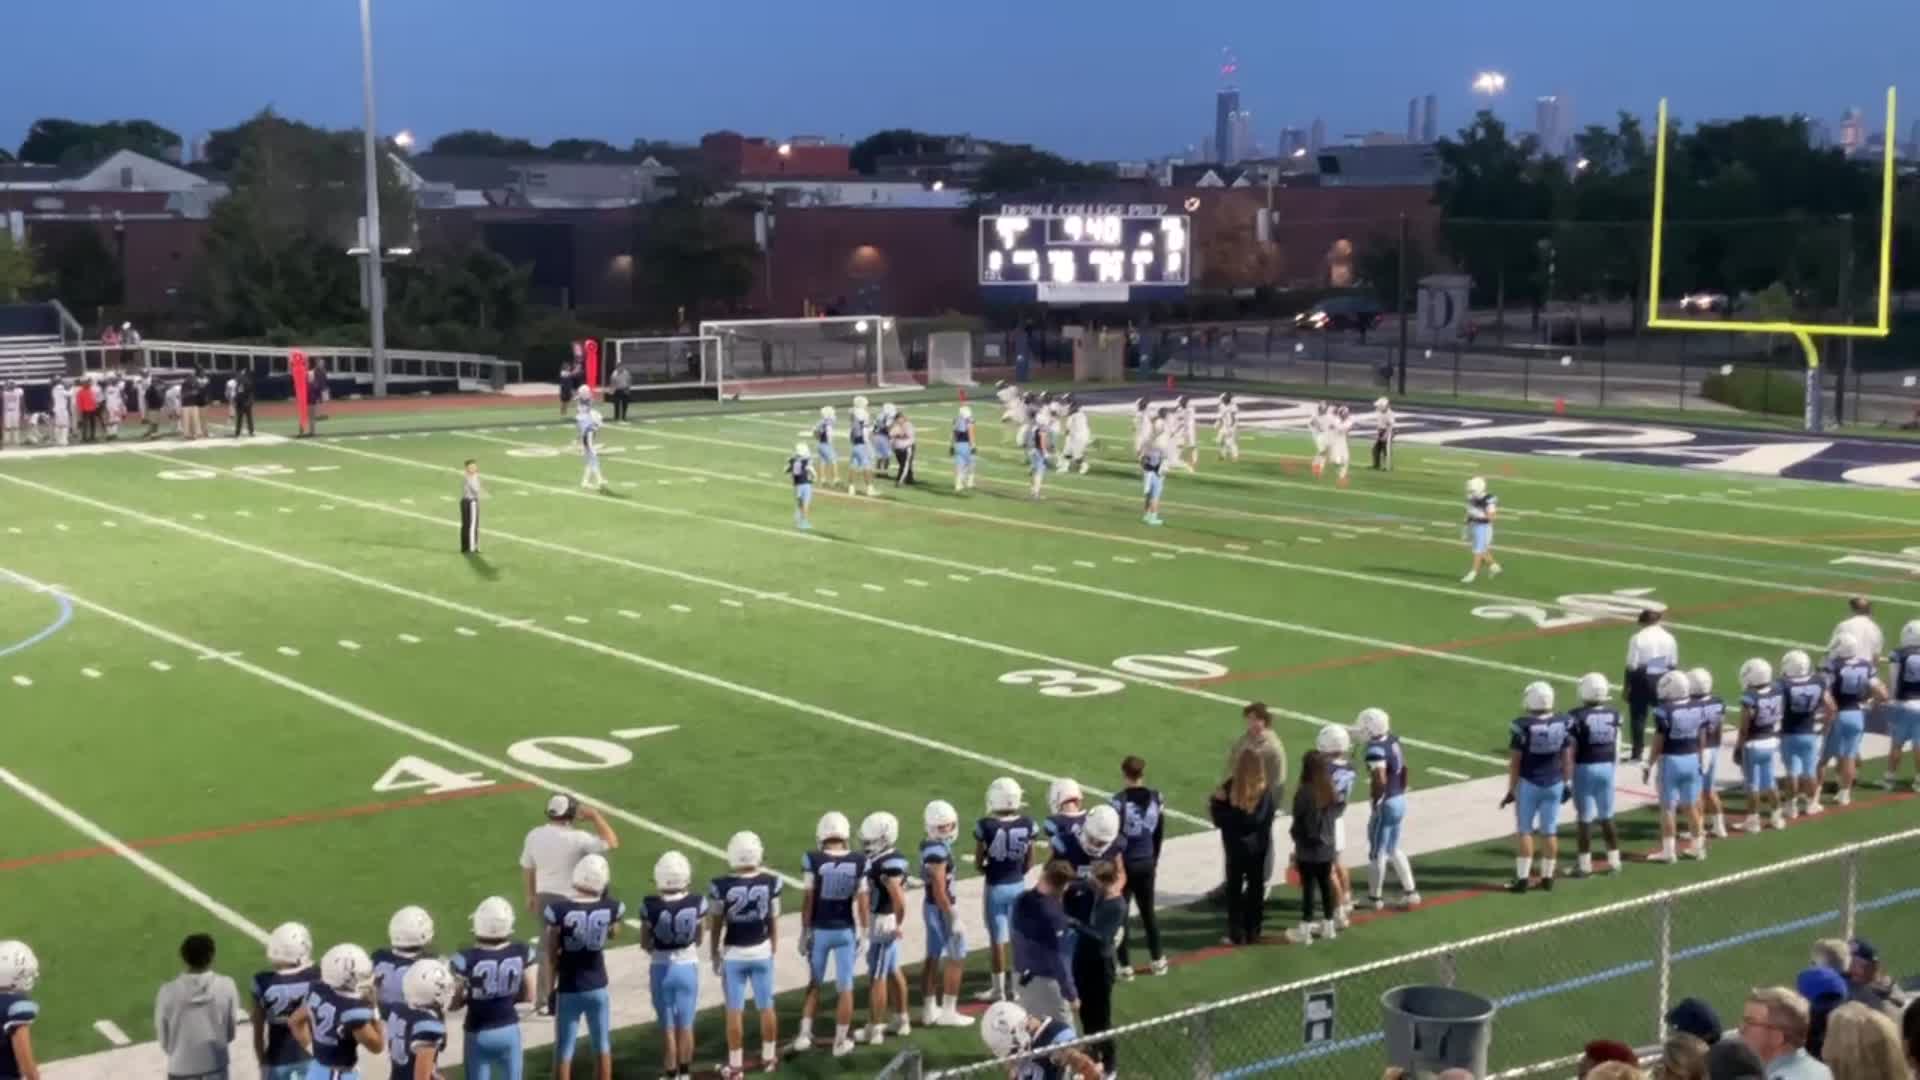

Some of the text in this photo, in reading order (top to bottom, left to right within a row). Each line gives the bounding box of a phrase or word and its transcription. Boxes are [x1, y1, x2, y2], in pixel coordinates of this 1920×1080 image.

[997, 654, 1229, 698] 30
[372, 736, 633, 794] 40
[988, 827, 1030, 864] 45
[472, 956, 523, 999] 30
